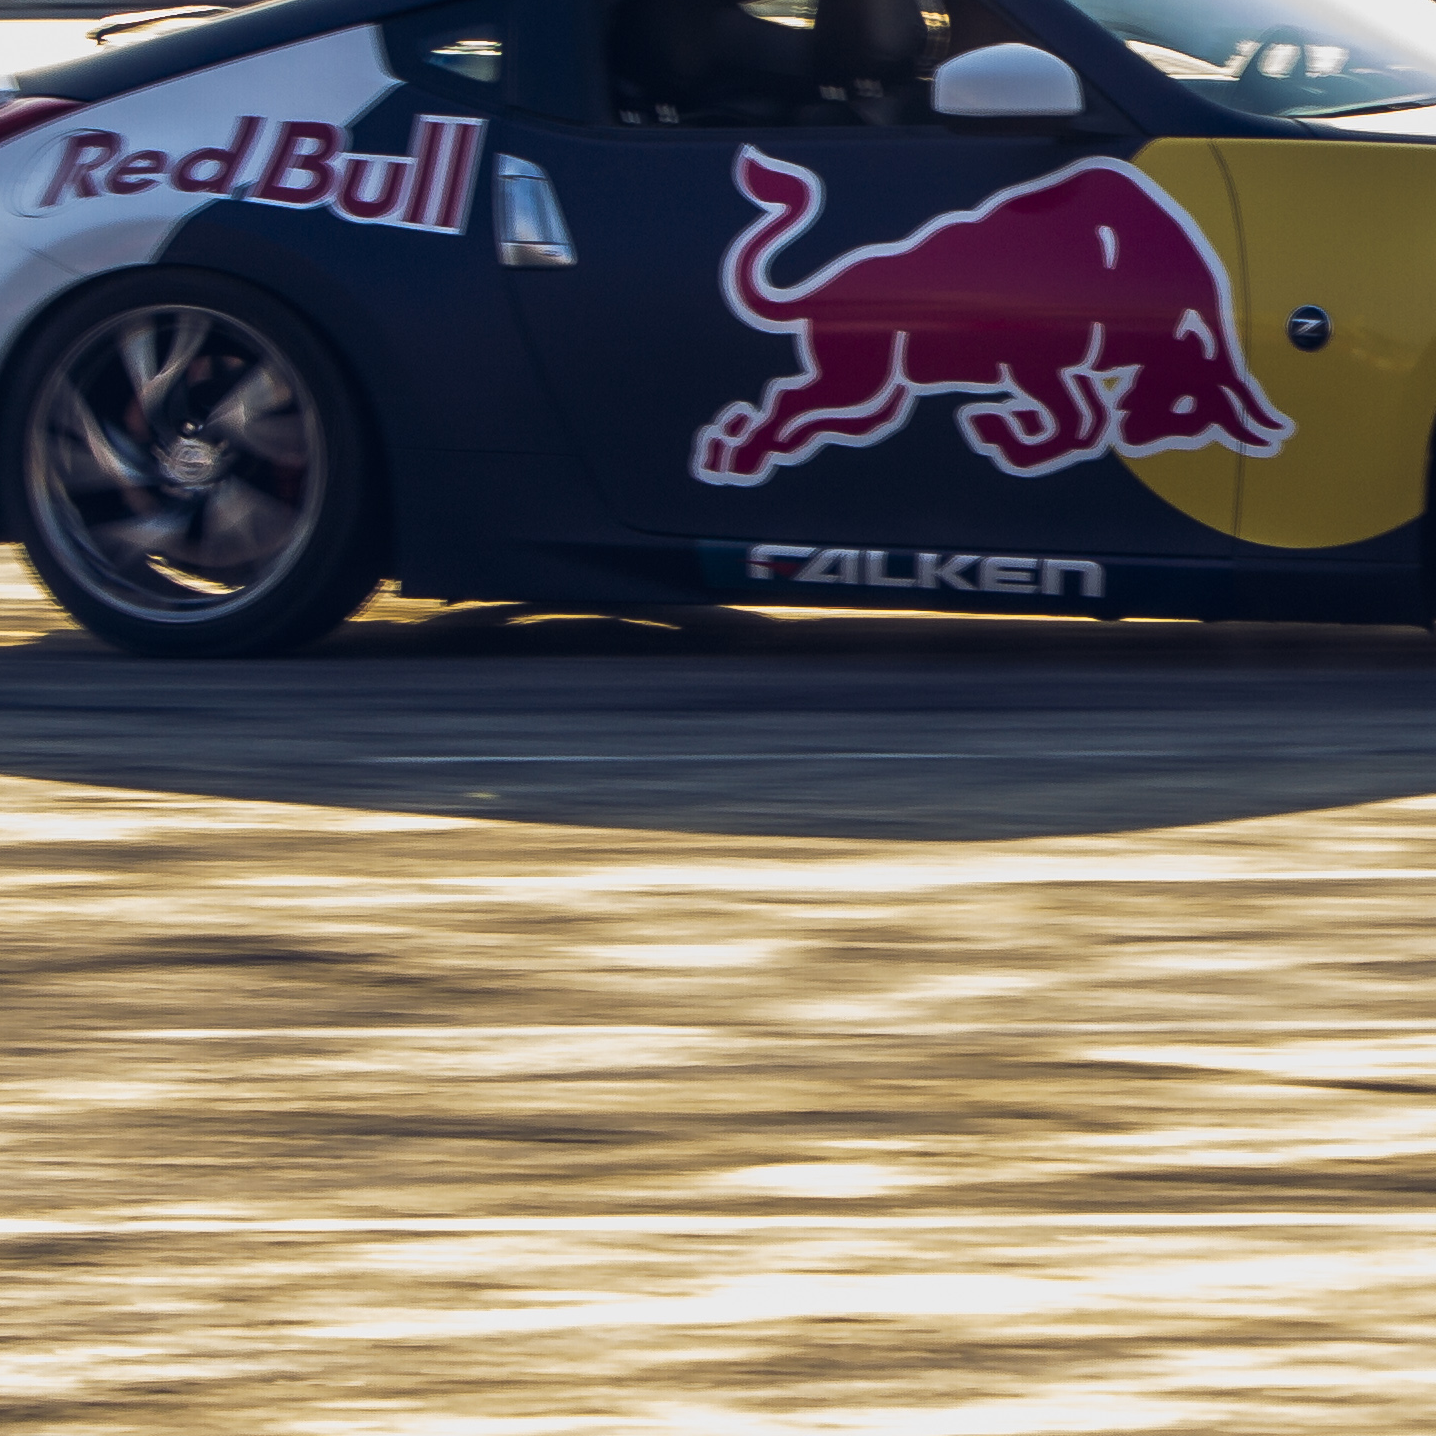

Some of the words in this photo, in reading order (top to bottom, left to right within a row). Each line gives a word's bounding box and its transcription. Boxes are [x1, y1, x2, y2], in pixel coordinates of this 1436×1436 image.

[38, 114, 266, 209] Red
[252, 116, 486, 233] Bull
[747, 544, 1106, 598] FALKEN
